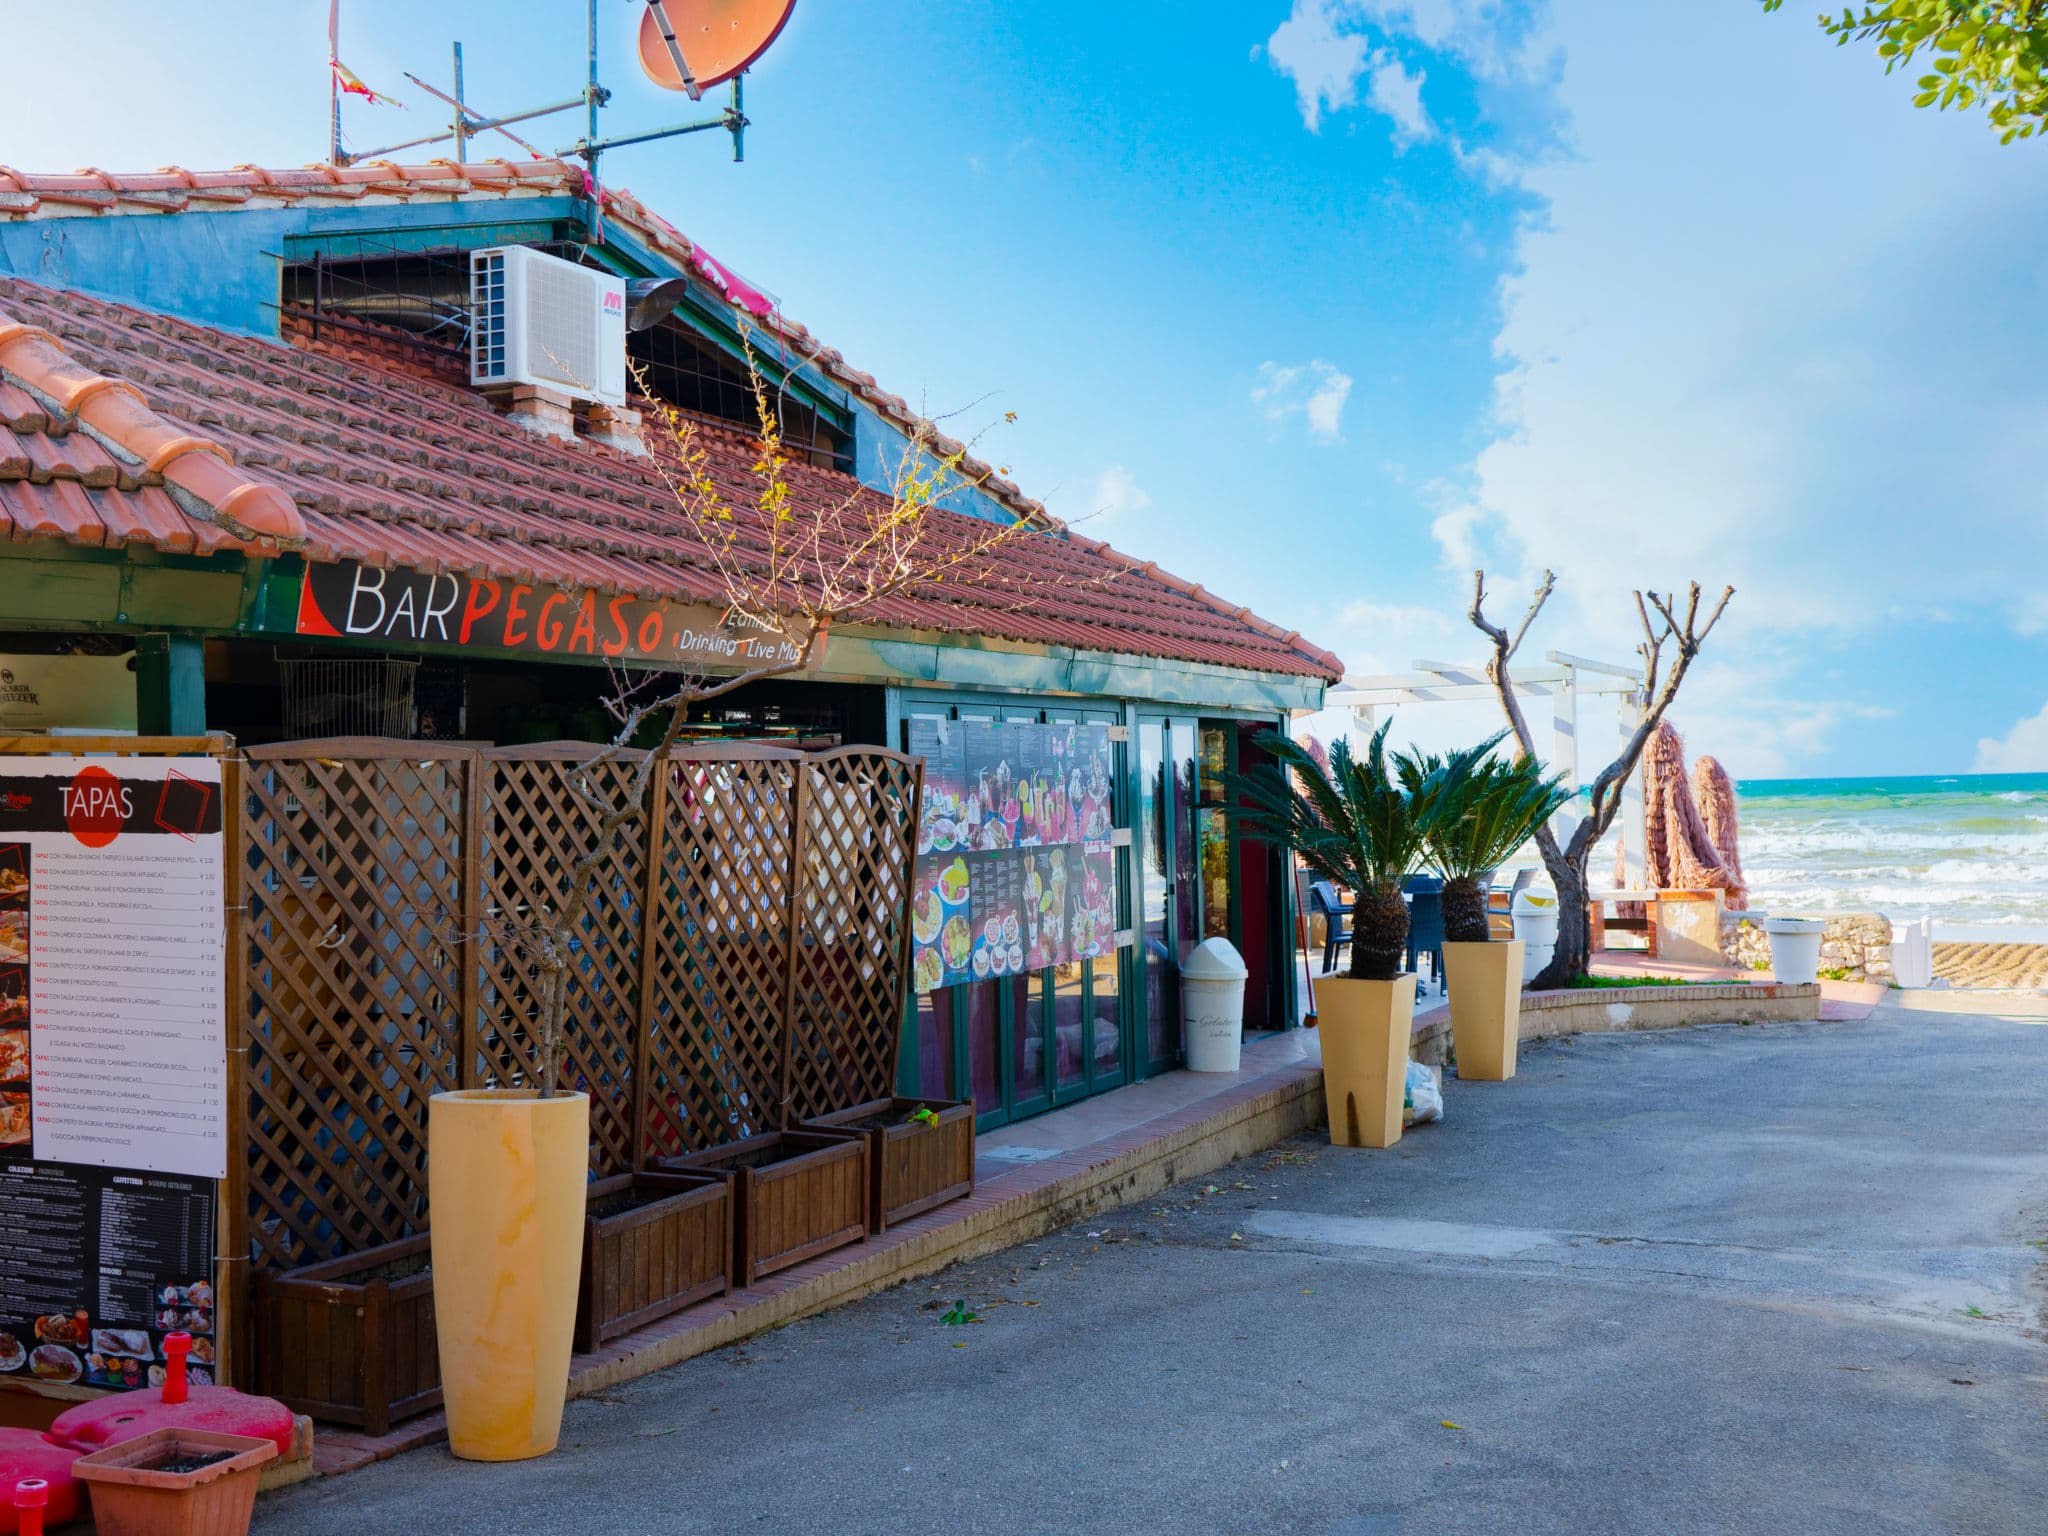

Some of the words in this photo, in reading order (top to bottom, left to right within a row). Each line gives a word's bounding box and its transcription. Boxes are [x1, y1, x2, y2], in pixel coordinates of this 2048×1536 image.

[346, 566, 459, 640] BAR
[680, 629, 737, 656] Drinking
[746, 641, 775, 659] Live
[58, 786, 134, 819] TAPAS
